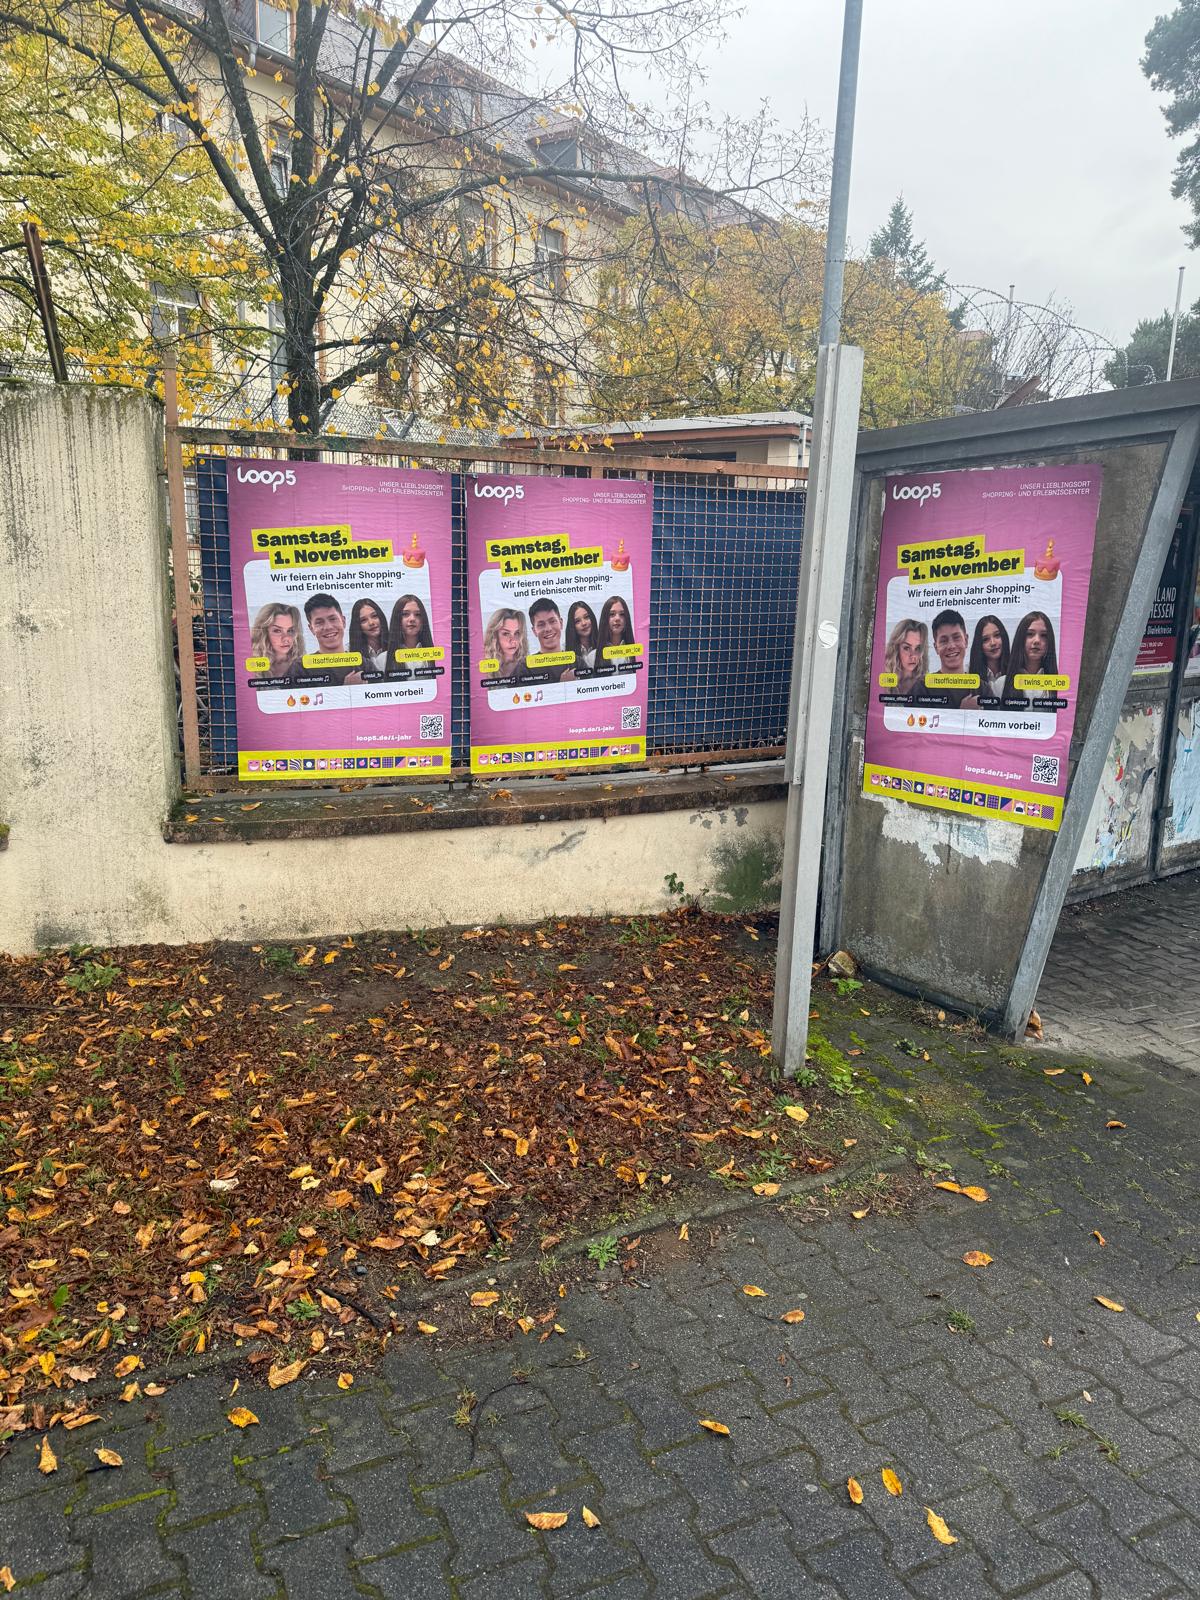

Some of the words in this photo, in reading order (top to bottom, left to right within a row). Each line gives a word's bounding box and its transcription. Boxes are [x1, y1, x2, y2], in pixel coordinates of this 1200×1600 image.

[1042, 480, 1091, 489] LIEBLINGSORT
[982, 491, 1016, 499] SHOPPING-
[1032, 488, 1090, 497] ERLEBNISCENTER
[257, 530, 348, 548] Samstag,
[490, 538, 566, 557] Samstag,
[900, 541, 981, 564] Samstag,
[274, 550, 290, 565] 1.
[295, 545, 388, 563] November
[504, 560, 518, 573] 1.
[521, 552, 600, 571] November
[912, 567, 926, 580] 1.
[929, 556, 1020, 579] November
[271, 573, 287, 583] Wir
[289, 572, 317, 582] feiern
[319, 571, 334, 581] ein
[336, 571, 356, 580] Jahr
[358, 570, 406, 582] Shopping-
[501, 581, 515, 590] Wir
[517, 579, 541, 588] feiern
[542, 578, 554, 586] ein
[555, 577, 572, 585] Jahr
[574, 574, 613, 586] Shopping-
[286, 582, 304, 592] und
[306, 581, 374, 591] Erlebniscenter
[376, 580, 393, 589] mit:
[513, 589, 529, 598] und
[531, 585, 587, 596] Erlebniscenter
[907, 589, 922, 598] Wir
[923, 587, 948, 597] feiern
[949, 586, 962, 595] ein
[964, 585, 985, 595] Jahr
[986, 583, 1036, 596] Shopping-
[918, 599, 935, 608] und
[936, 596, 1001, 607] Erlebniscenter
[1002, 595, 1021, 604] mit:
[364, 690, 392, 700] Komm
[394, 687, 424, 698] vorbei!
[576, 686, 600, 695] Komm
[601, 682, 626, 692] vorbei!
[978, 718, 1007, 729] Komm
[1008, 720, 1041, 731] vorbei!
[964, 765, 1023, 781] loop5.de/1-jahr
